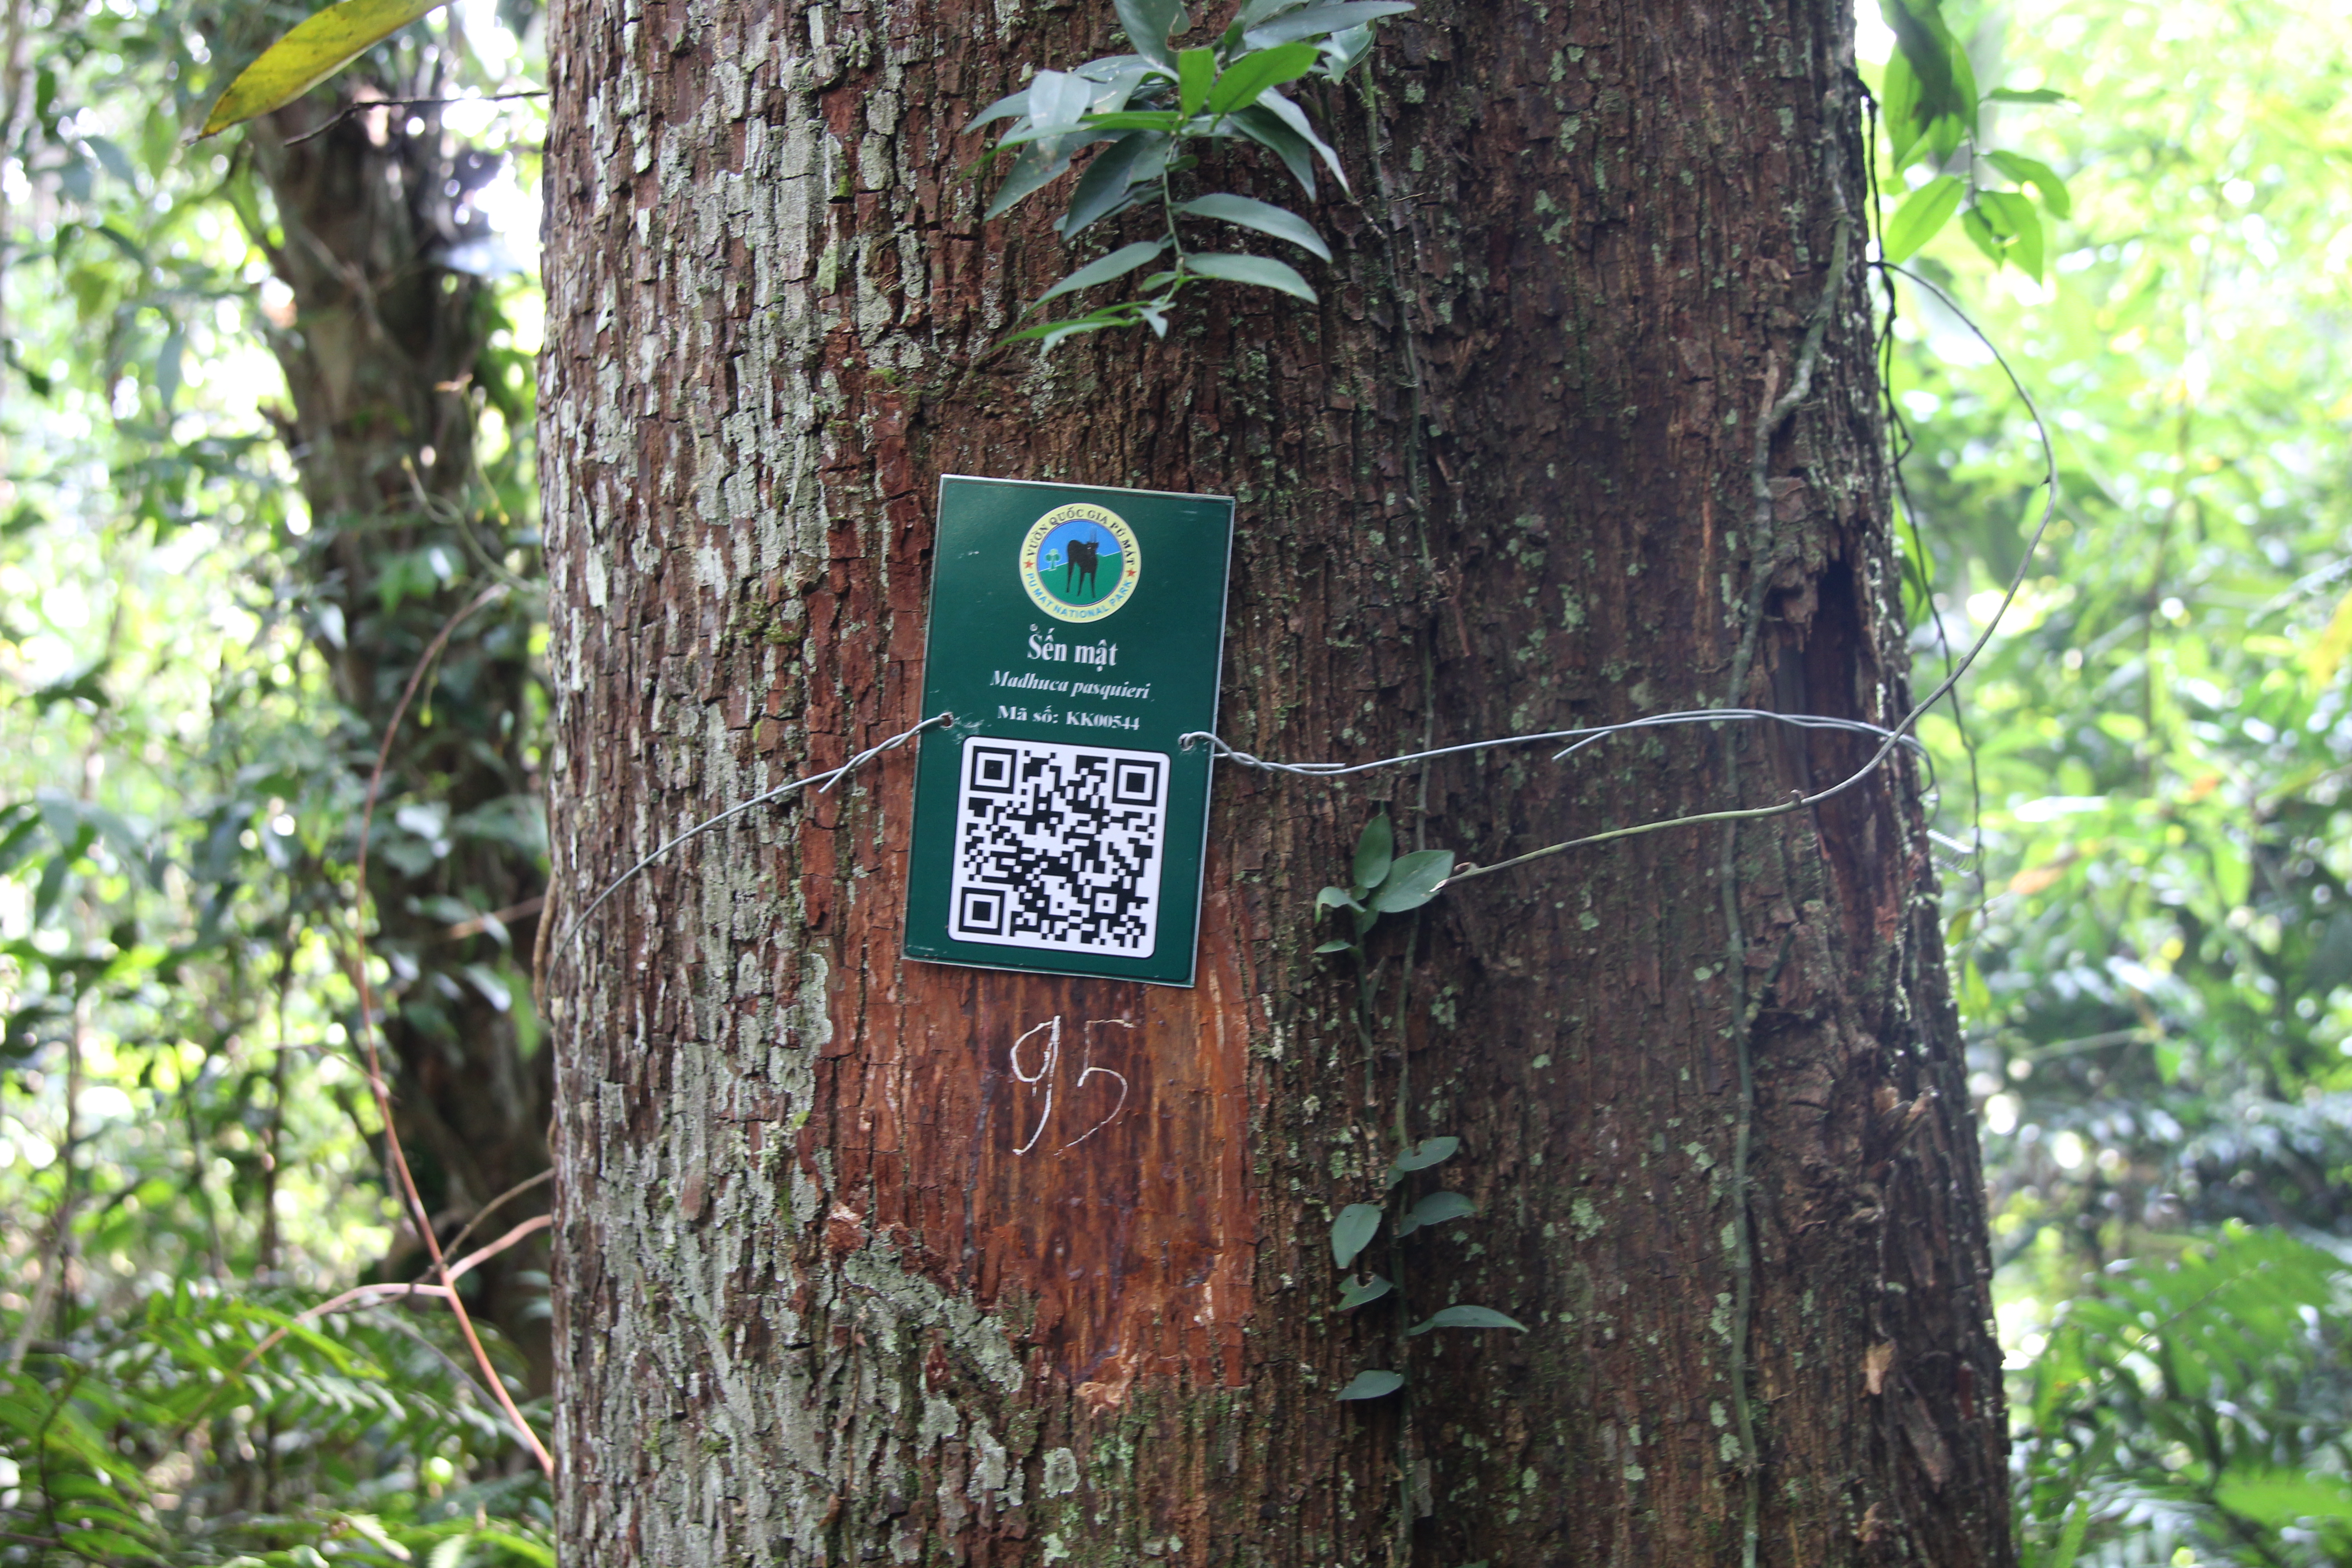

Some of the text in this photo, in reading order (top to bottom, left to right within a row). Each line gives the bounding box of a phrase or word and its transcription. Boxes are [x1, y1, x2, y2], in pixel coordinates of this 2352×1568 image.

[1088, 510, 1108, 524] GIA
[1026, 573, 1132, 618] PU MAT NATIONAL PARK
[1027, 627, 1118, 672] Sến mật
[990, 670, 1151, 700] Madhuca pasquieri
[997, 705, 1140, 730] Mã số: KK00544
[1010, 1014, 1137, 1156] 95
